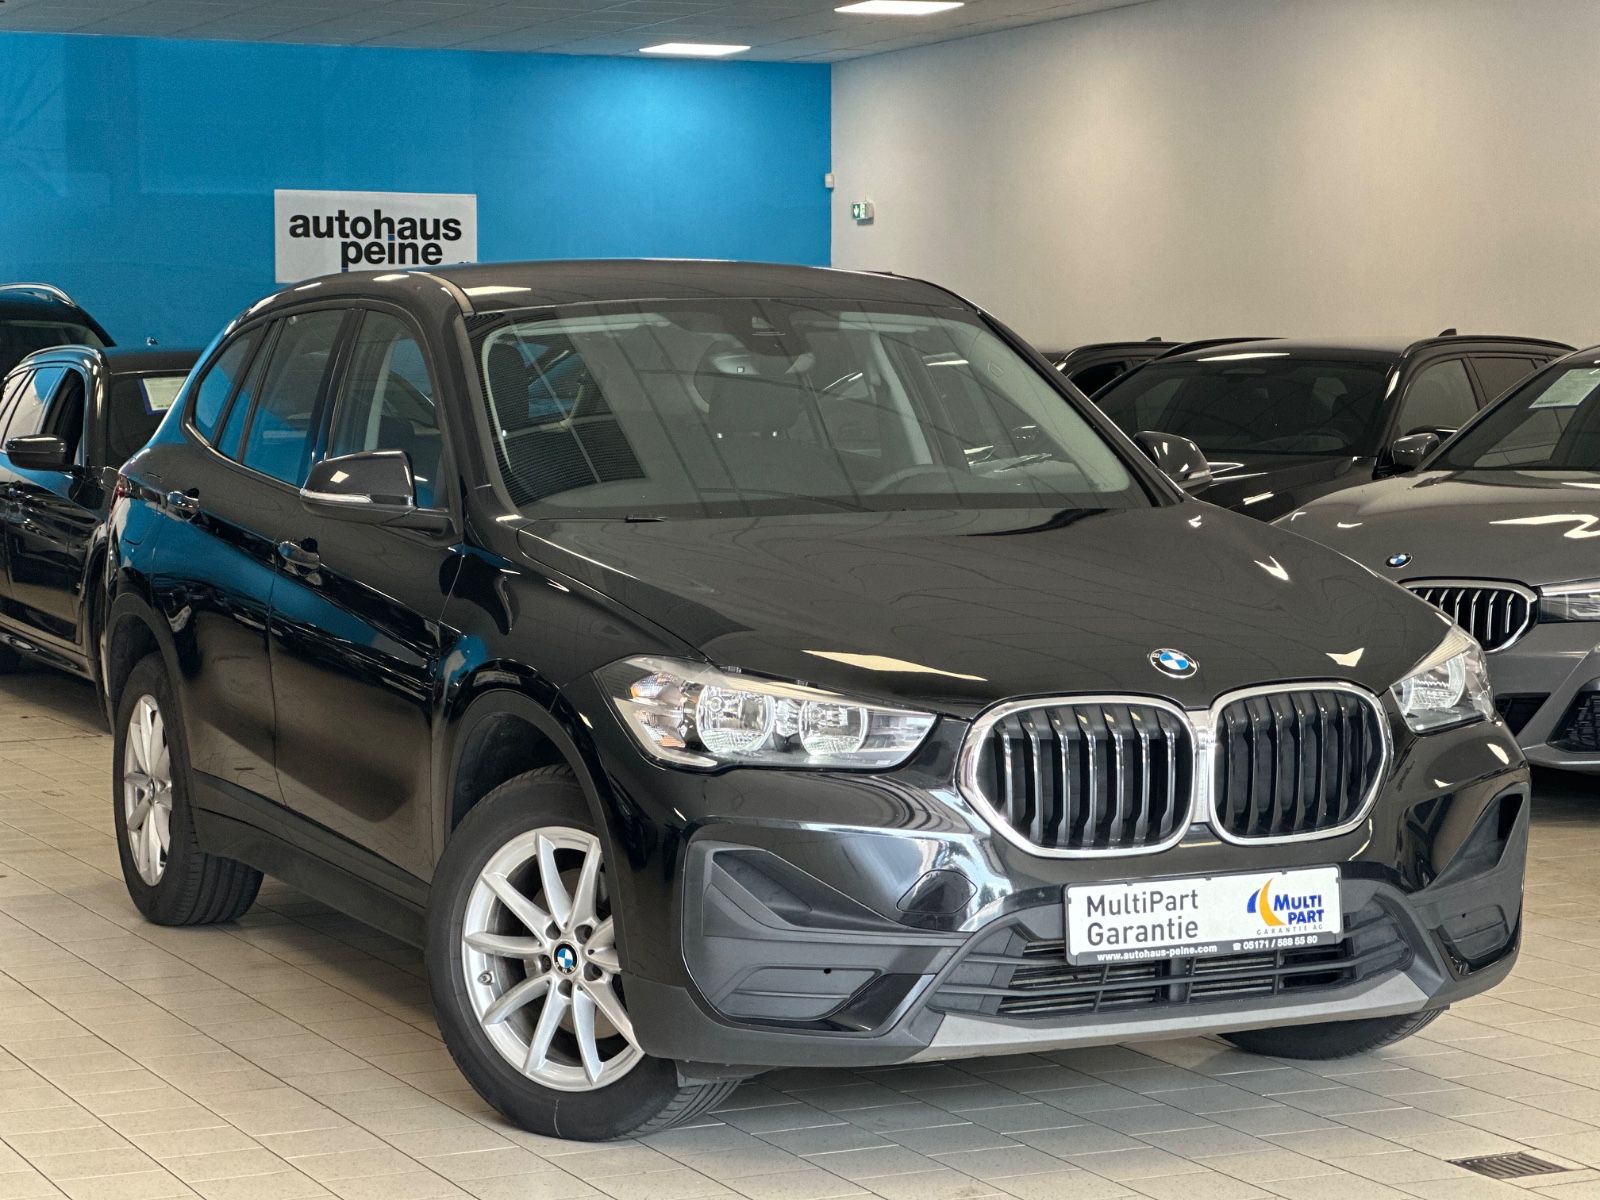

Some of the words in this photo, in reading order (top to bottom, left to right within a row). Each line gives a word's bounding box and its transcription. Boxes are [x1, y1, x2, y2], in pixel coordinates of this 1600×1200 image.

[289, 209, 462, 241] autohaus
[340, 235, 443, 272] peine
[1086, 889, 1199, 917] MultiPart
[1273, 893, 1322, 911] MULTI
[1287, 909, 1325, 925] PART
[1087, 915, 1199, 946] Garantie
[1256, 925, 1307, 936] GARANTIE
[1312, 923, 1323, 931] AG
[1096, 944, 1218, 962] www.autohaus-peine.com
[1242, 939, 1269, 950] 05171
